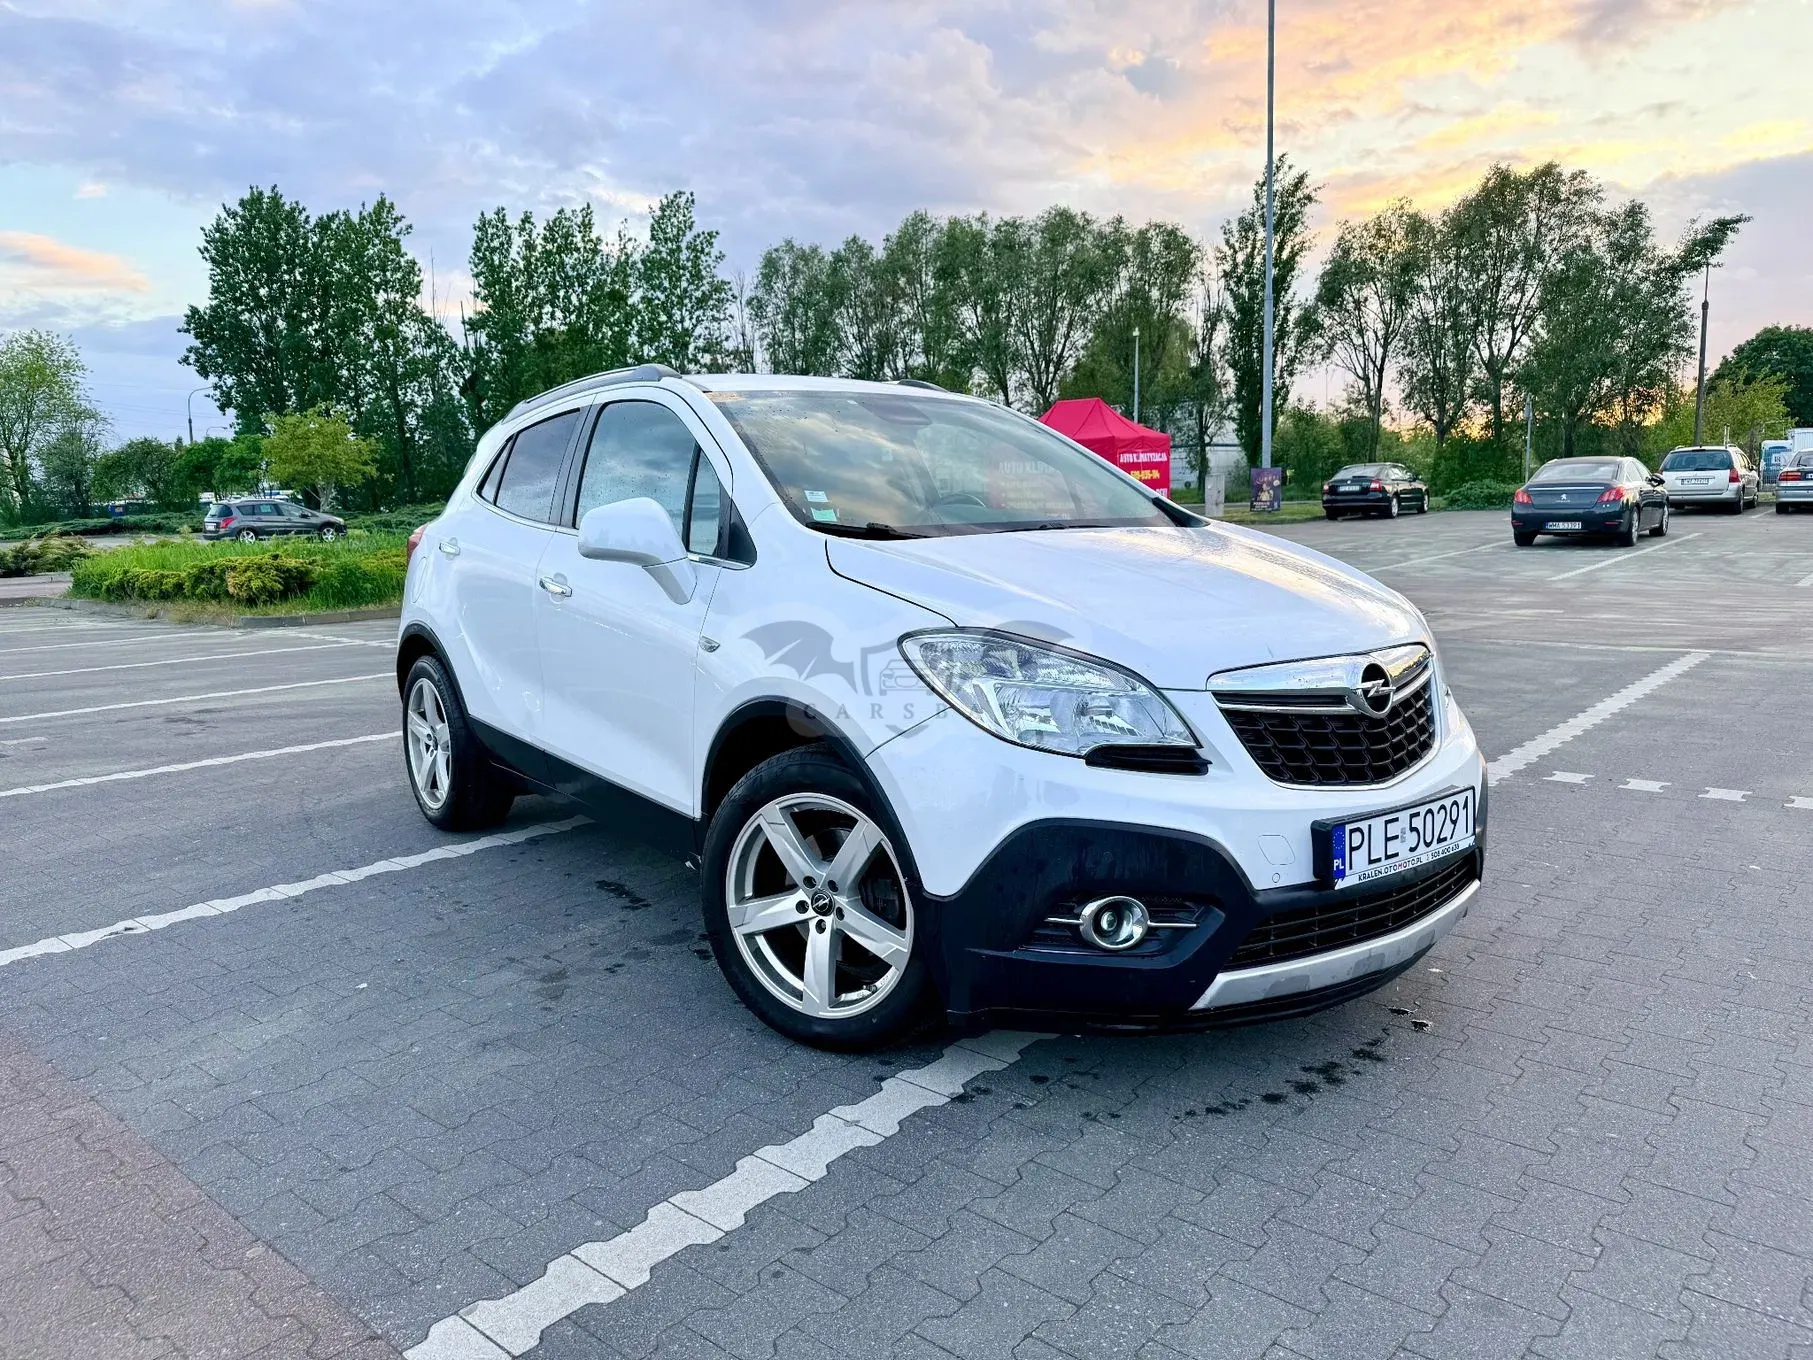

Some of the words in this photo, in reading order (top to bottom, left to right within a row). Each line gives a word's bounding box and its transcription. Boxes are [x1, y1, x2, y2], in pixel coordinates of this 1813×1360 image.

[1349, 817, 1399, 871] PLE
[1408, 796, 1469, 852] 50291
[1333, 858, 1344, 871] PL
